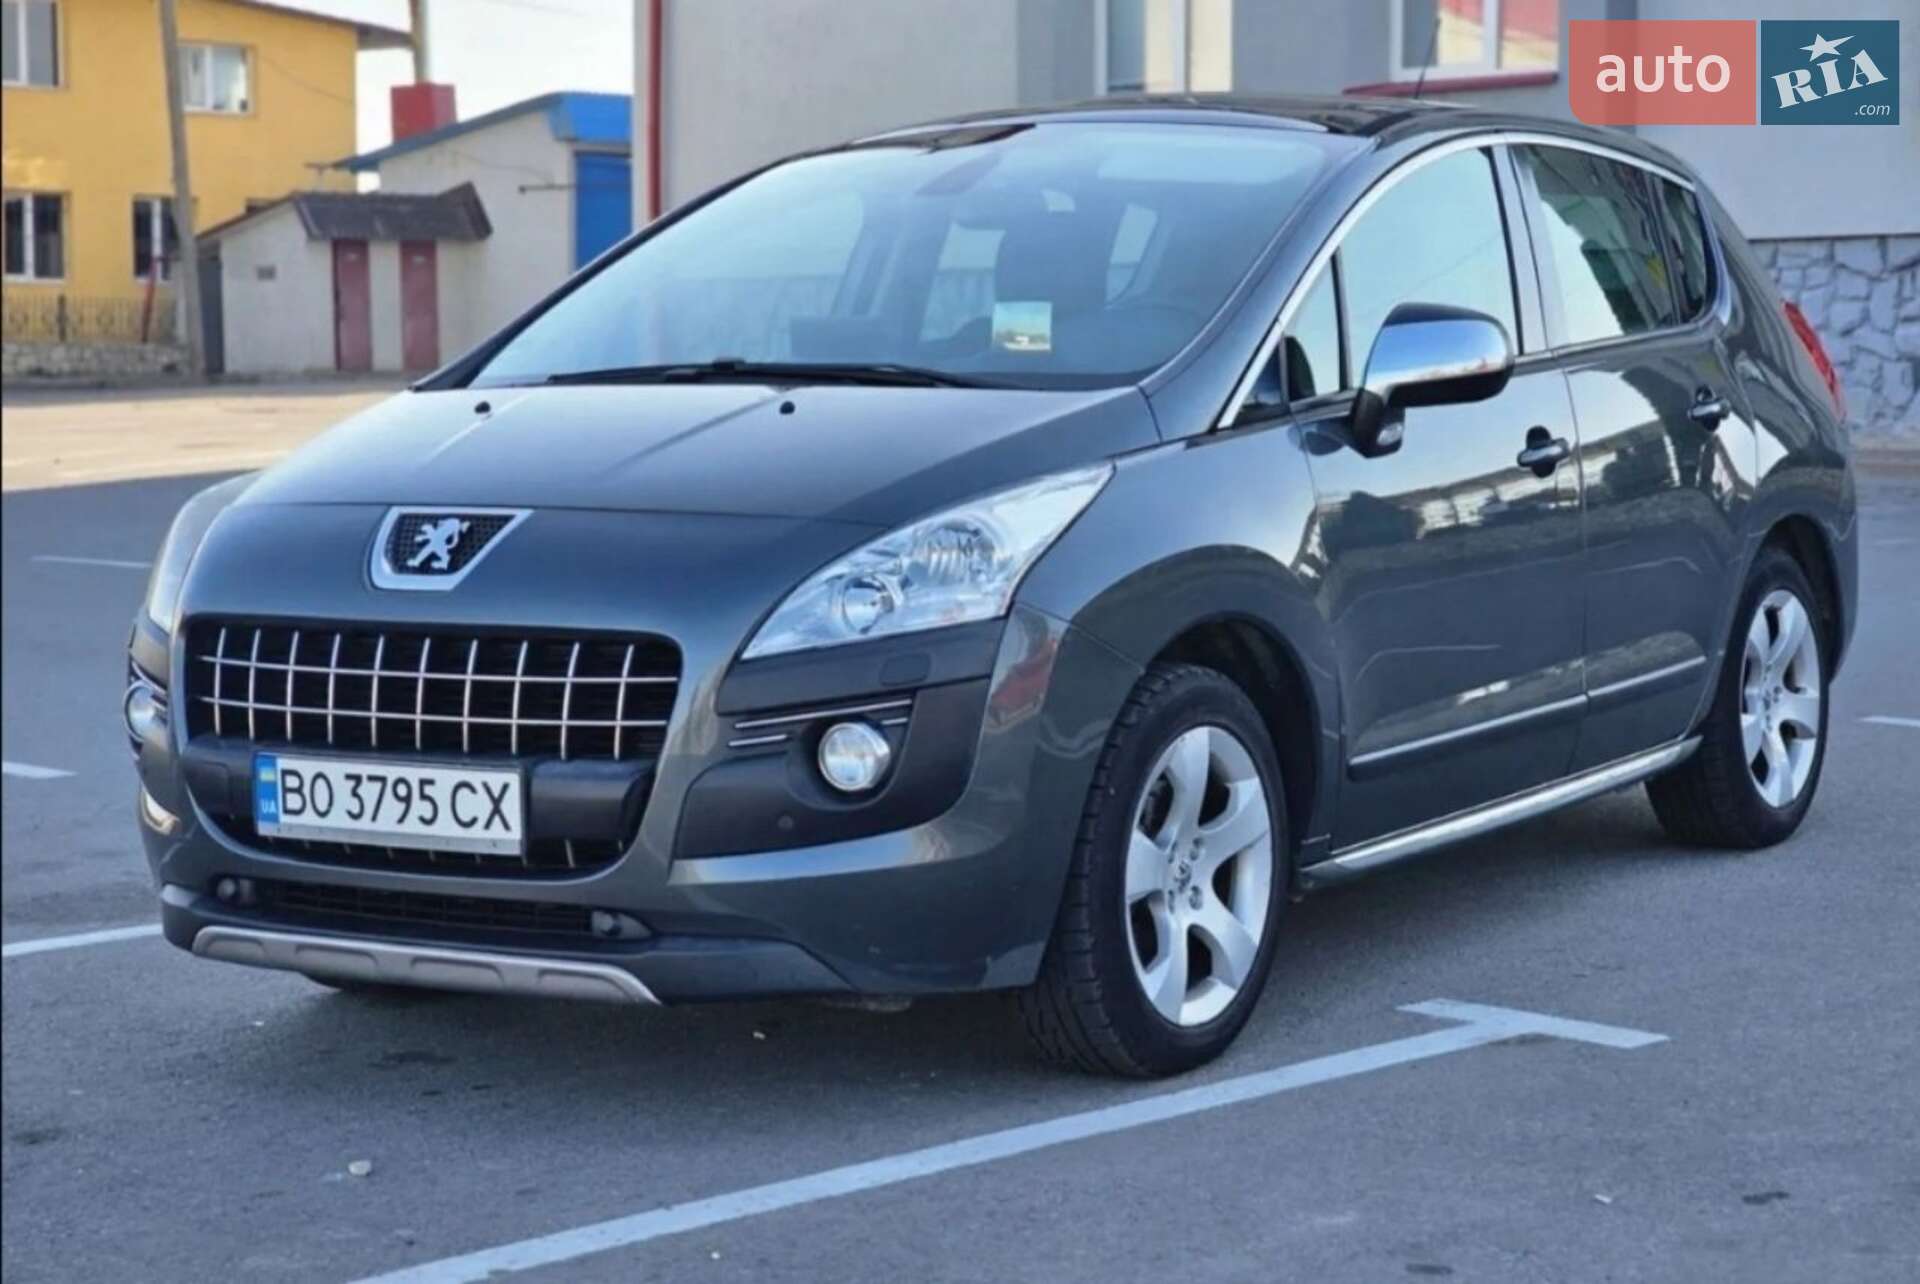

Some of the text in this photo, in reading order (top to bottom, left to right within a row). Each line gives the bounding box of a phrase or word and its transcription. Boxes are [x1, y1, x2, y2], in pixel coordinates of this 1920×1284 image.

[261, 802, 277, 814] UA
[281, 769, 512, 832] BO 3795 CX
